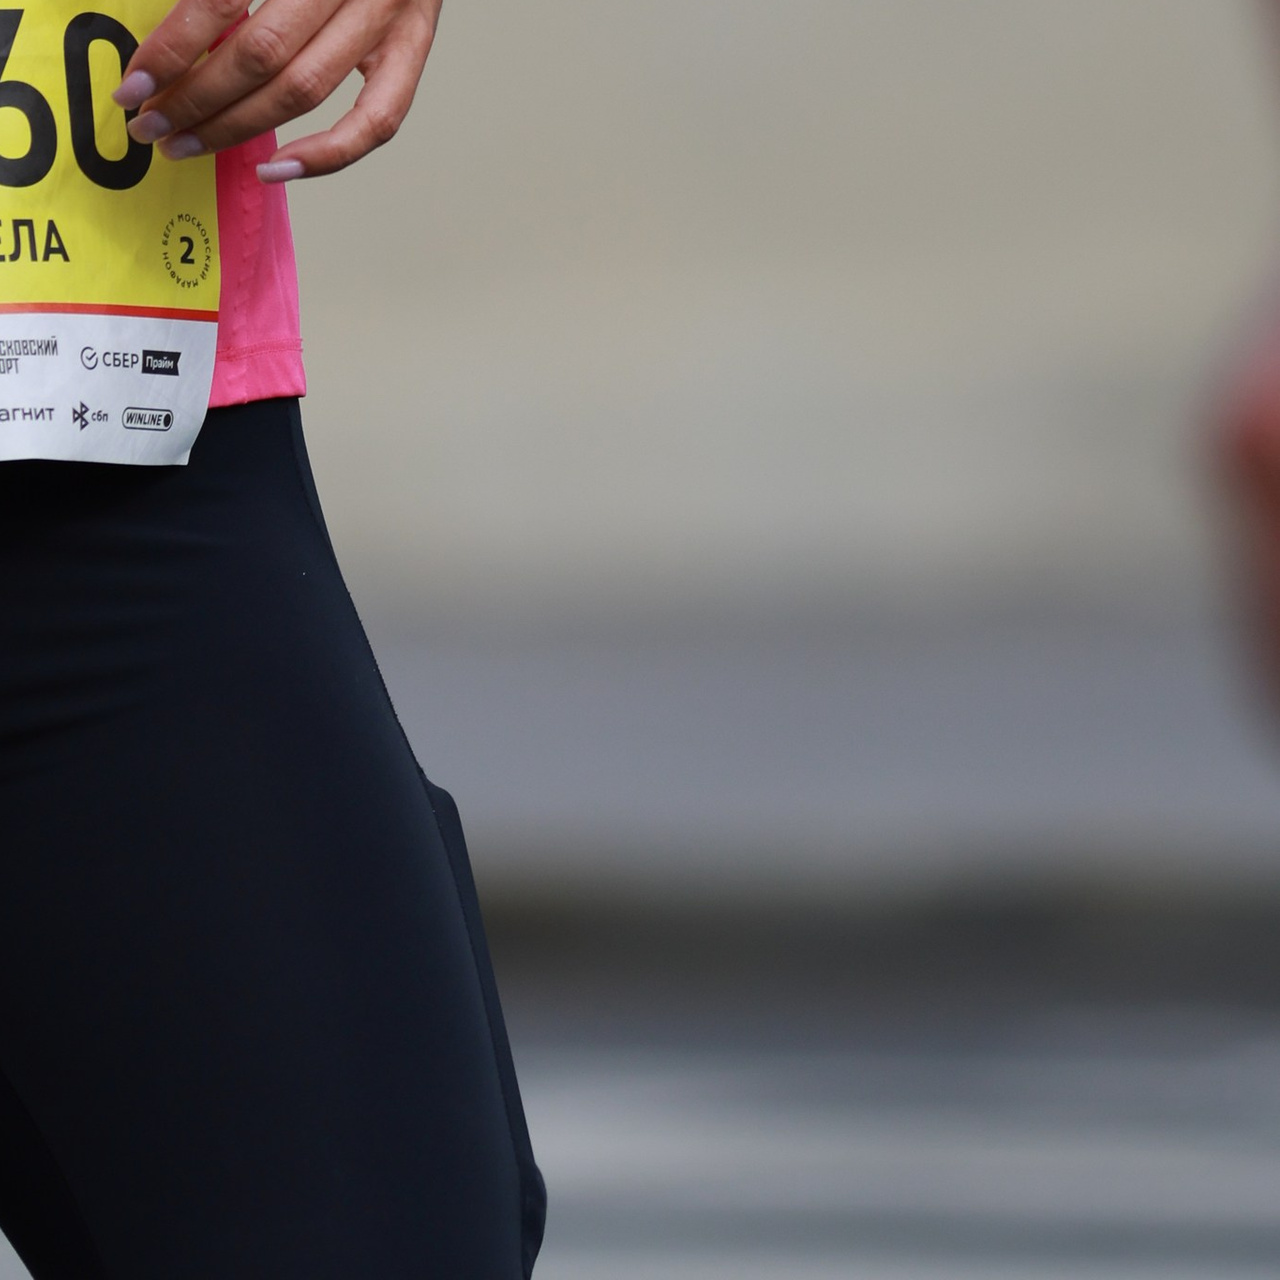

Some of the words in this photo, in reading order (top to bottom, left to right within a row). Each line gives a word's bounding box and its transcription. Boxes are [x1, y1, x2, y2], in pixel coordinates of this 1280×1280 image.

[179, 235, 195, 265] 2
[102, 351, 139, 369] СБЕР
[145, 355, 174, 370] Прайм
[125, 411, 163, 426] WINLINE
